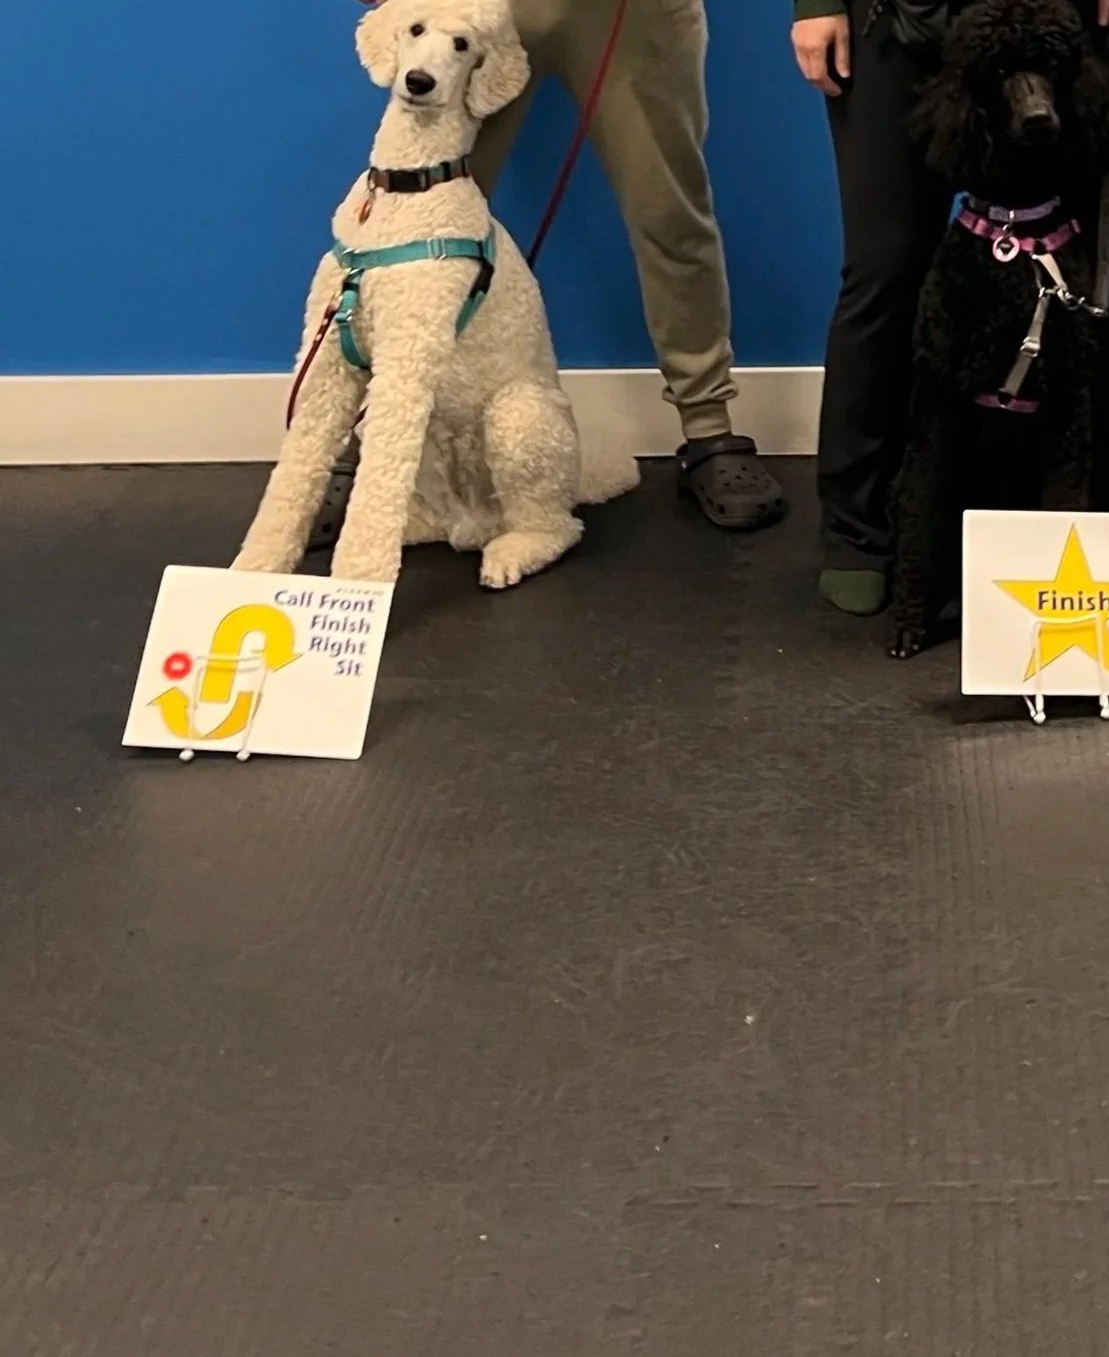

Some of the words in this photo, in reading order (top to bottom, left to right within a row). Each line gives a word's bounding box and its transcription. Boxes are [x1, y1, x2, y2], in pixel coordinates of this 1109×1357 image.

[274, 589, 315, 609] Call
[319, 593, 376, 612] Front
[309, 614, 372, 635] Finish
[308, 636, 367, 658] Right
[334, 659, 364, 677] Sit
